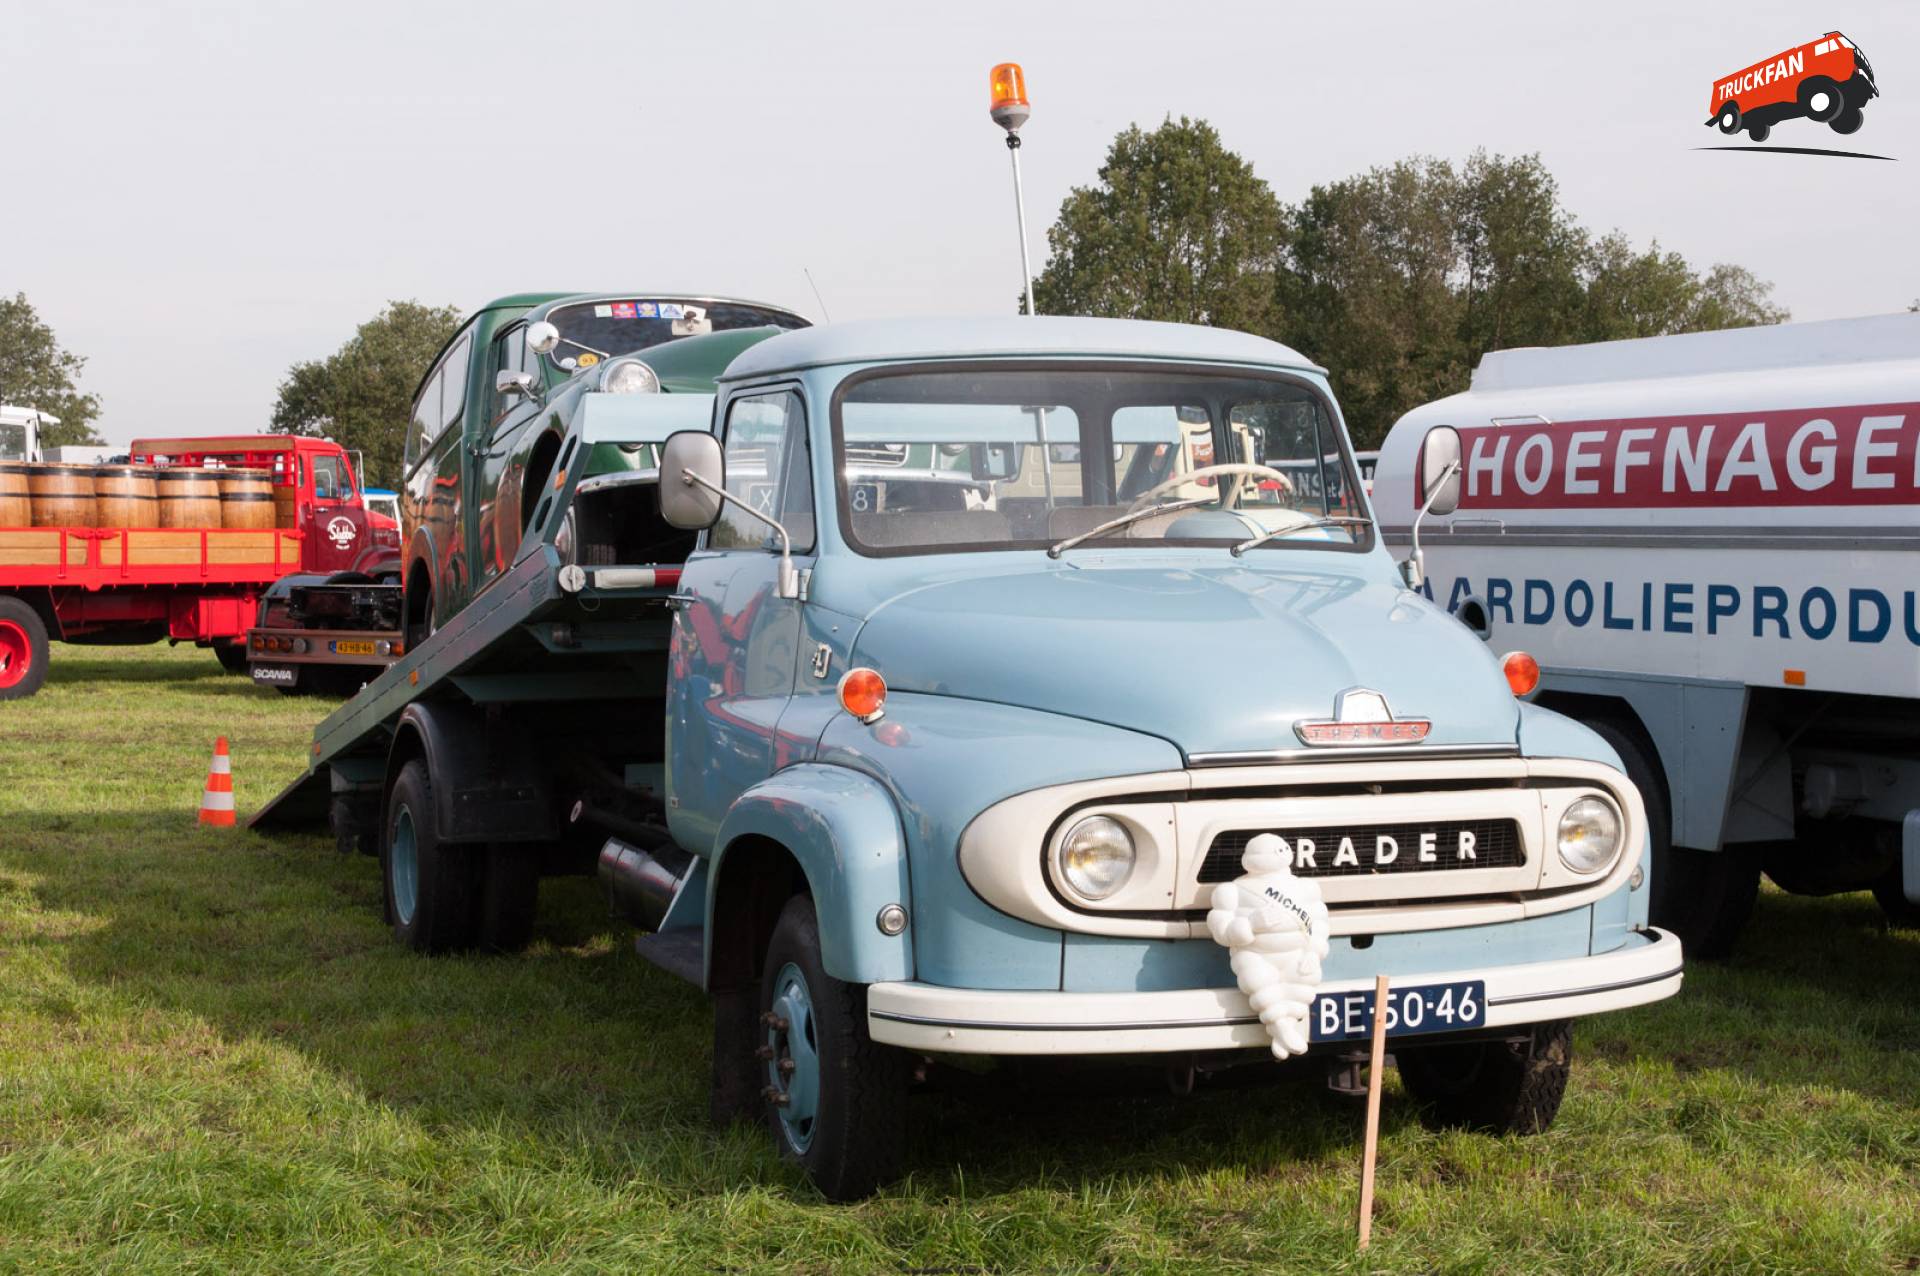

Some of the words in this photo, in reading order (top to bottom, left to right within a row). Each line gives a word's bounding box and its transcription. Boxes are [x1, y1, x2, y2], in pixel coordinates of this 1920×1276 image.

[1467, 413, 1920, 497] HOEFNAGE
[852, 488, 868, 512] 8
[253, 668, 293, 680] SCANIA
[1310, 725, 1421, 739] THAMES
[1296, 830, 1477, 869] RADER
[1319, 986, 1478, 1036] BE-50-46
